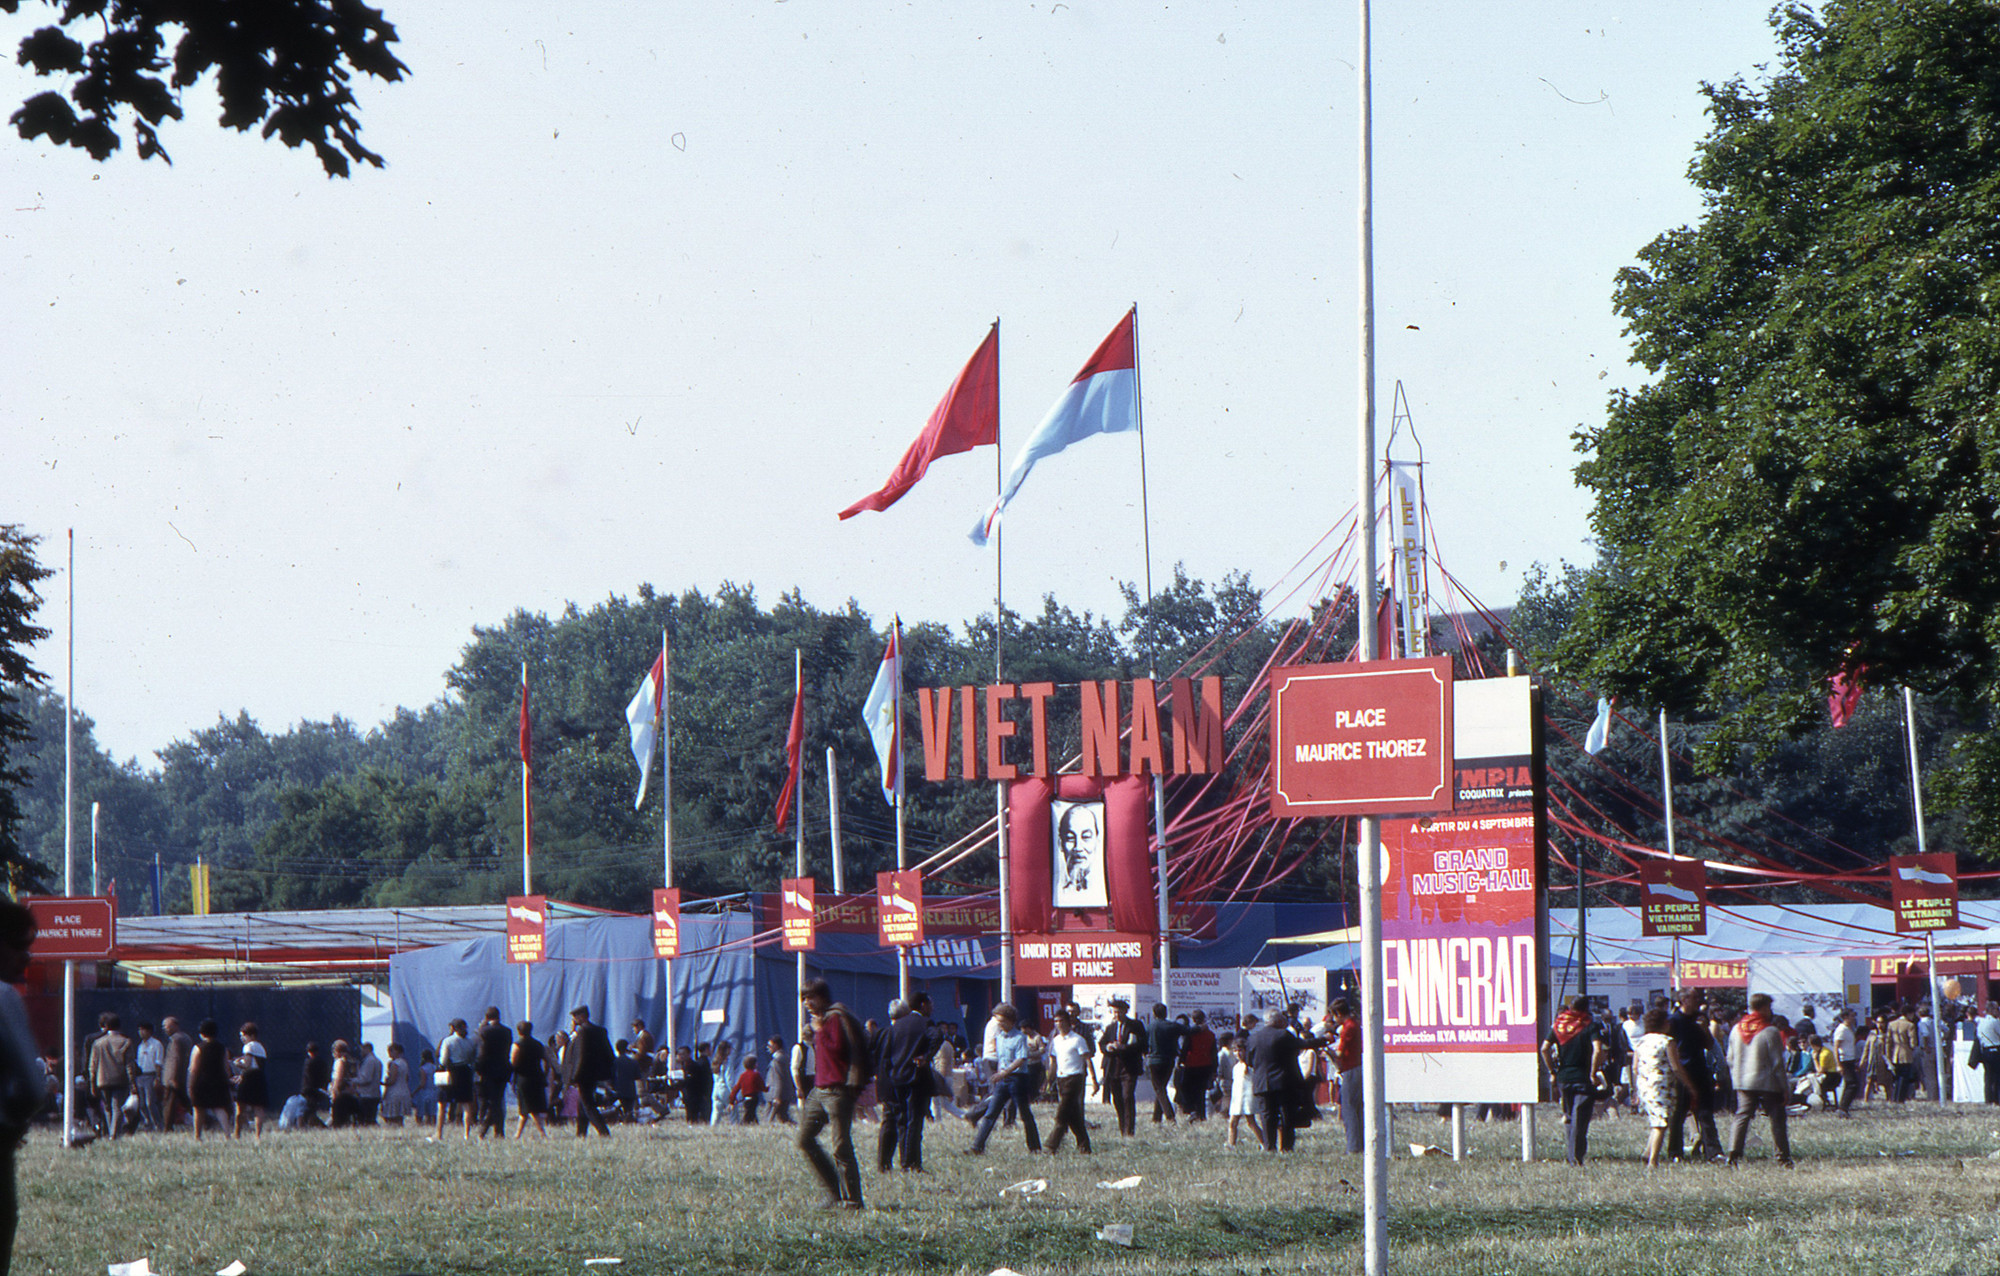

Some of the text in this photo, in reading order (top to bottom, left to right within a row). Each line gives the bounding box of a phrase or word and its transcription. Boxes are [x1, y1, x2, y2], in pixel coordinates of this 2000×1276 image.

[1400, 487, 1422, 653] LE PEUPLE
[1335, 708, 1386, 728] PLACE
[918, 676, 1224, 781] VIET NAM
[1295, 738, 1426, 763] MAURICE THOREZ
[1459, 788, 1504, 800] COQUATRIX
[1410, 823, 1419, 834] A
[1457, 819, 1470, 831] DU
[1472, 818, 1479, 830] 4
[1479, 816, 1535, 830] SEPTEMBRE
[1434, 848, 1509, 872] GRAND
[1648, 903, 1700, 913] LE PEUPLE
[1901, 898, 1952, 909] LE PEUPLE
[54, 914, 82, 925] PLACE
[1648, 913, 1701, 923] VIETNAMIEN
[1656, 924, 1694, 933] VAINCRA
[1020, 942, 1141, 959] UNION DES VIETNAMIENS
[1051, 962, 1114, 978] EN FRANCE
[1381, 935, 1537, 1027] ENINGRAD
[1393, 1030, 1436, 1045] production
[1437, 1030, 1456, 1043] ILYA
